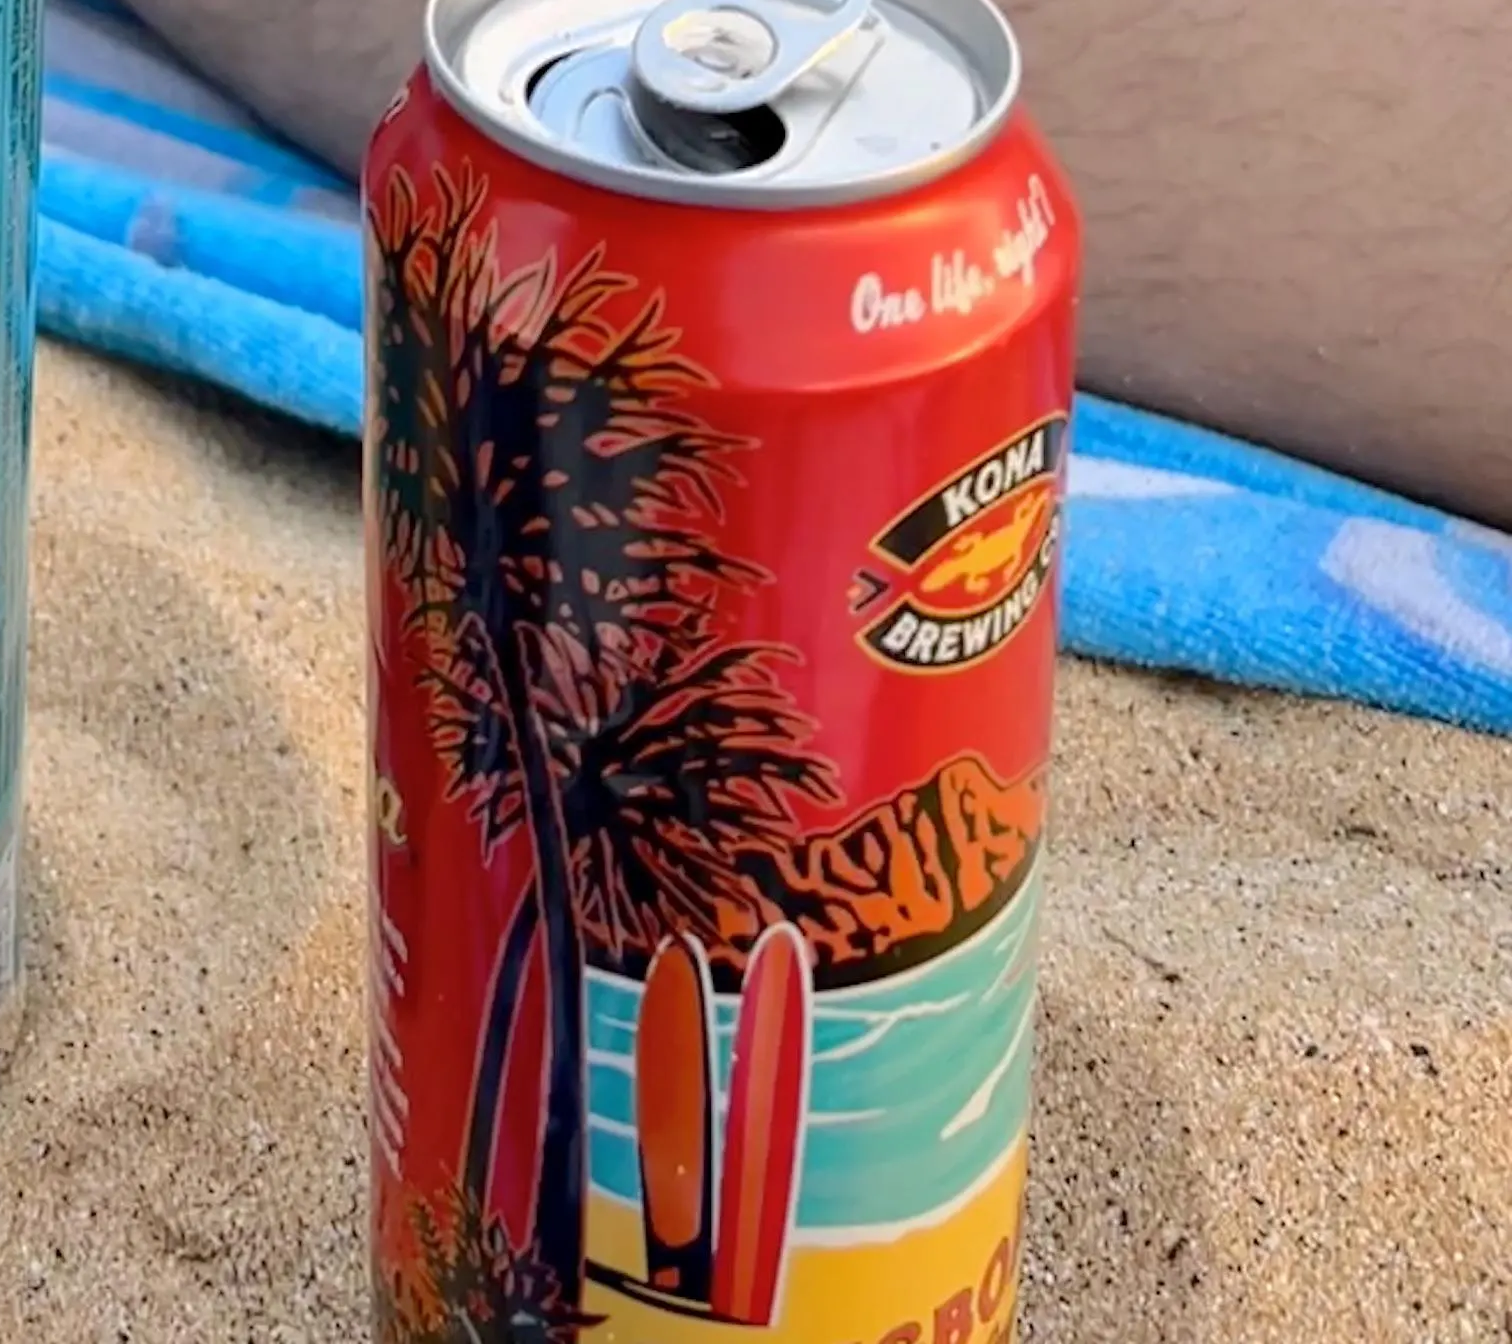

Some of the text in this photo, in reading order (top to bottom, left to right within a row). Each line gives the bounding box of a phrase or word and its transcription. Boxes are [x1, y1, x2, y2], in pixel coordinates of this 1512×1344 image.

[850, 271, 927, 334] One
[941, 429, 1045, 527] KONA
[880, 570, 1040, 663] BREWING
